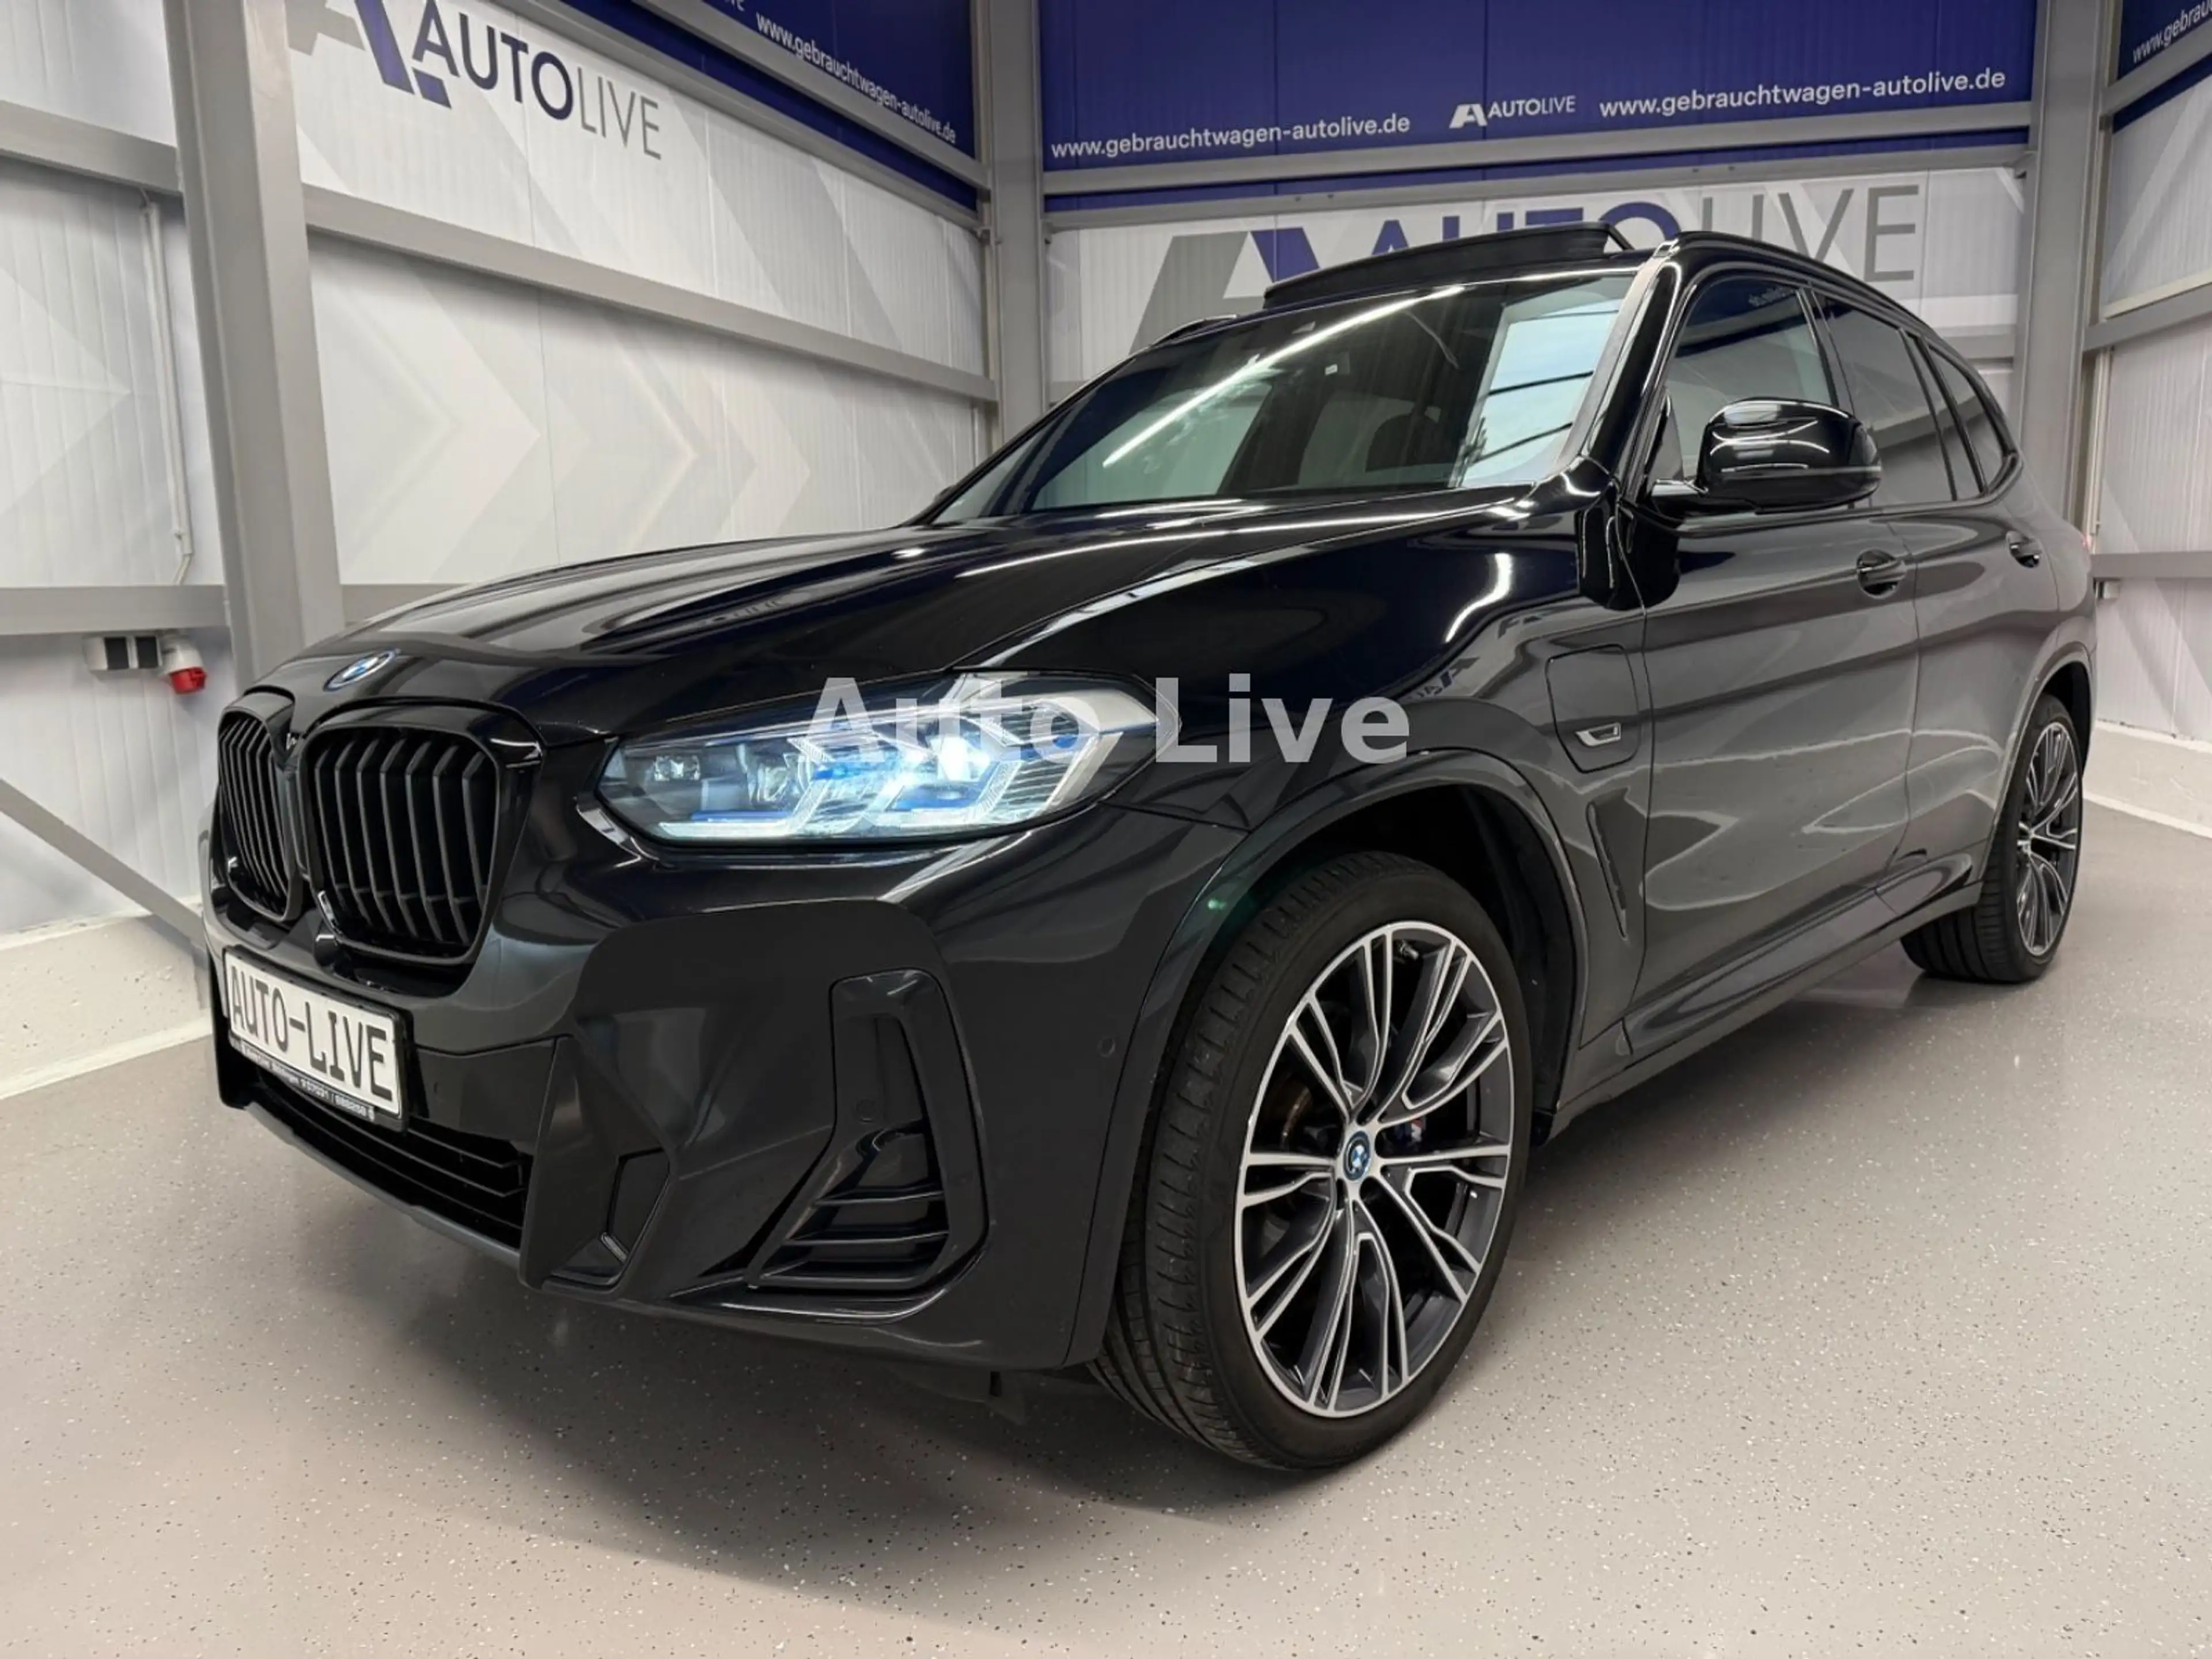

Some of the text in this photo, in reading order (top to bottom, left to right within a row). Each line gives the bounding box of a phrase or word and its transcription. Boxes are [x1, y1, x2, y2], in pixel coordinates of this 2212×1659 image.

[411, 0, 661, 160] AUTOLIVE
[756, 12, 957, 143] www.gebrauchtwagen-autolive.de
[1488, 95, 1577, 118] AUTOLIVE
[1599, 67, 2006, 118] www.gebrauchtwagen-autolive.de
[1051, 112, 1410, 158] www.gebrauchtwagen-autolive.de
[230, 965, 393, 1101] AUTO-LIVE
